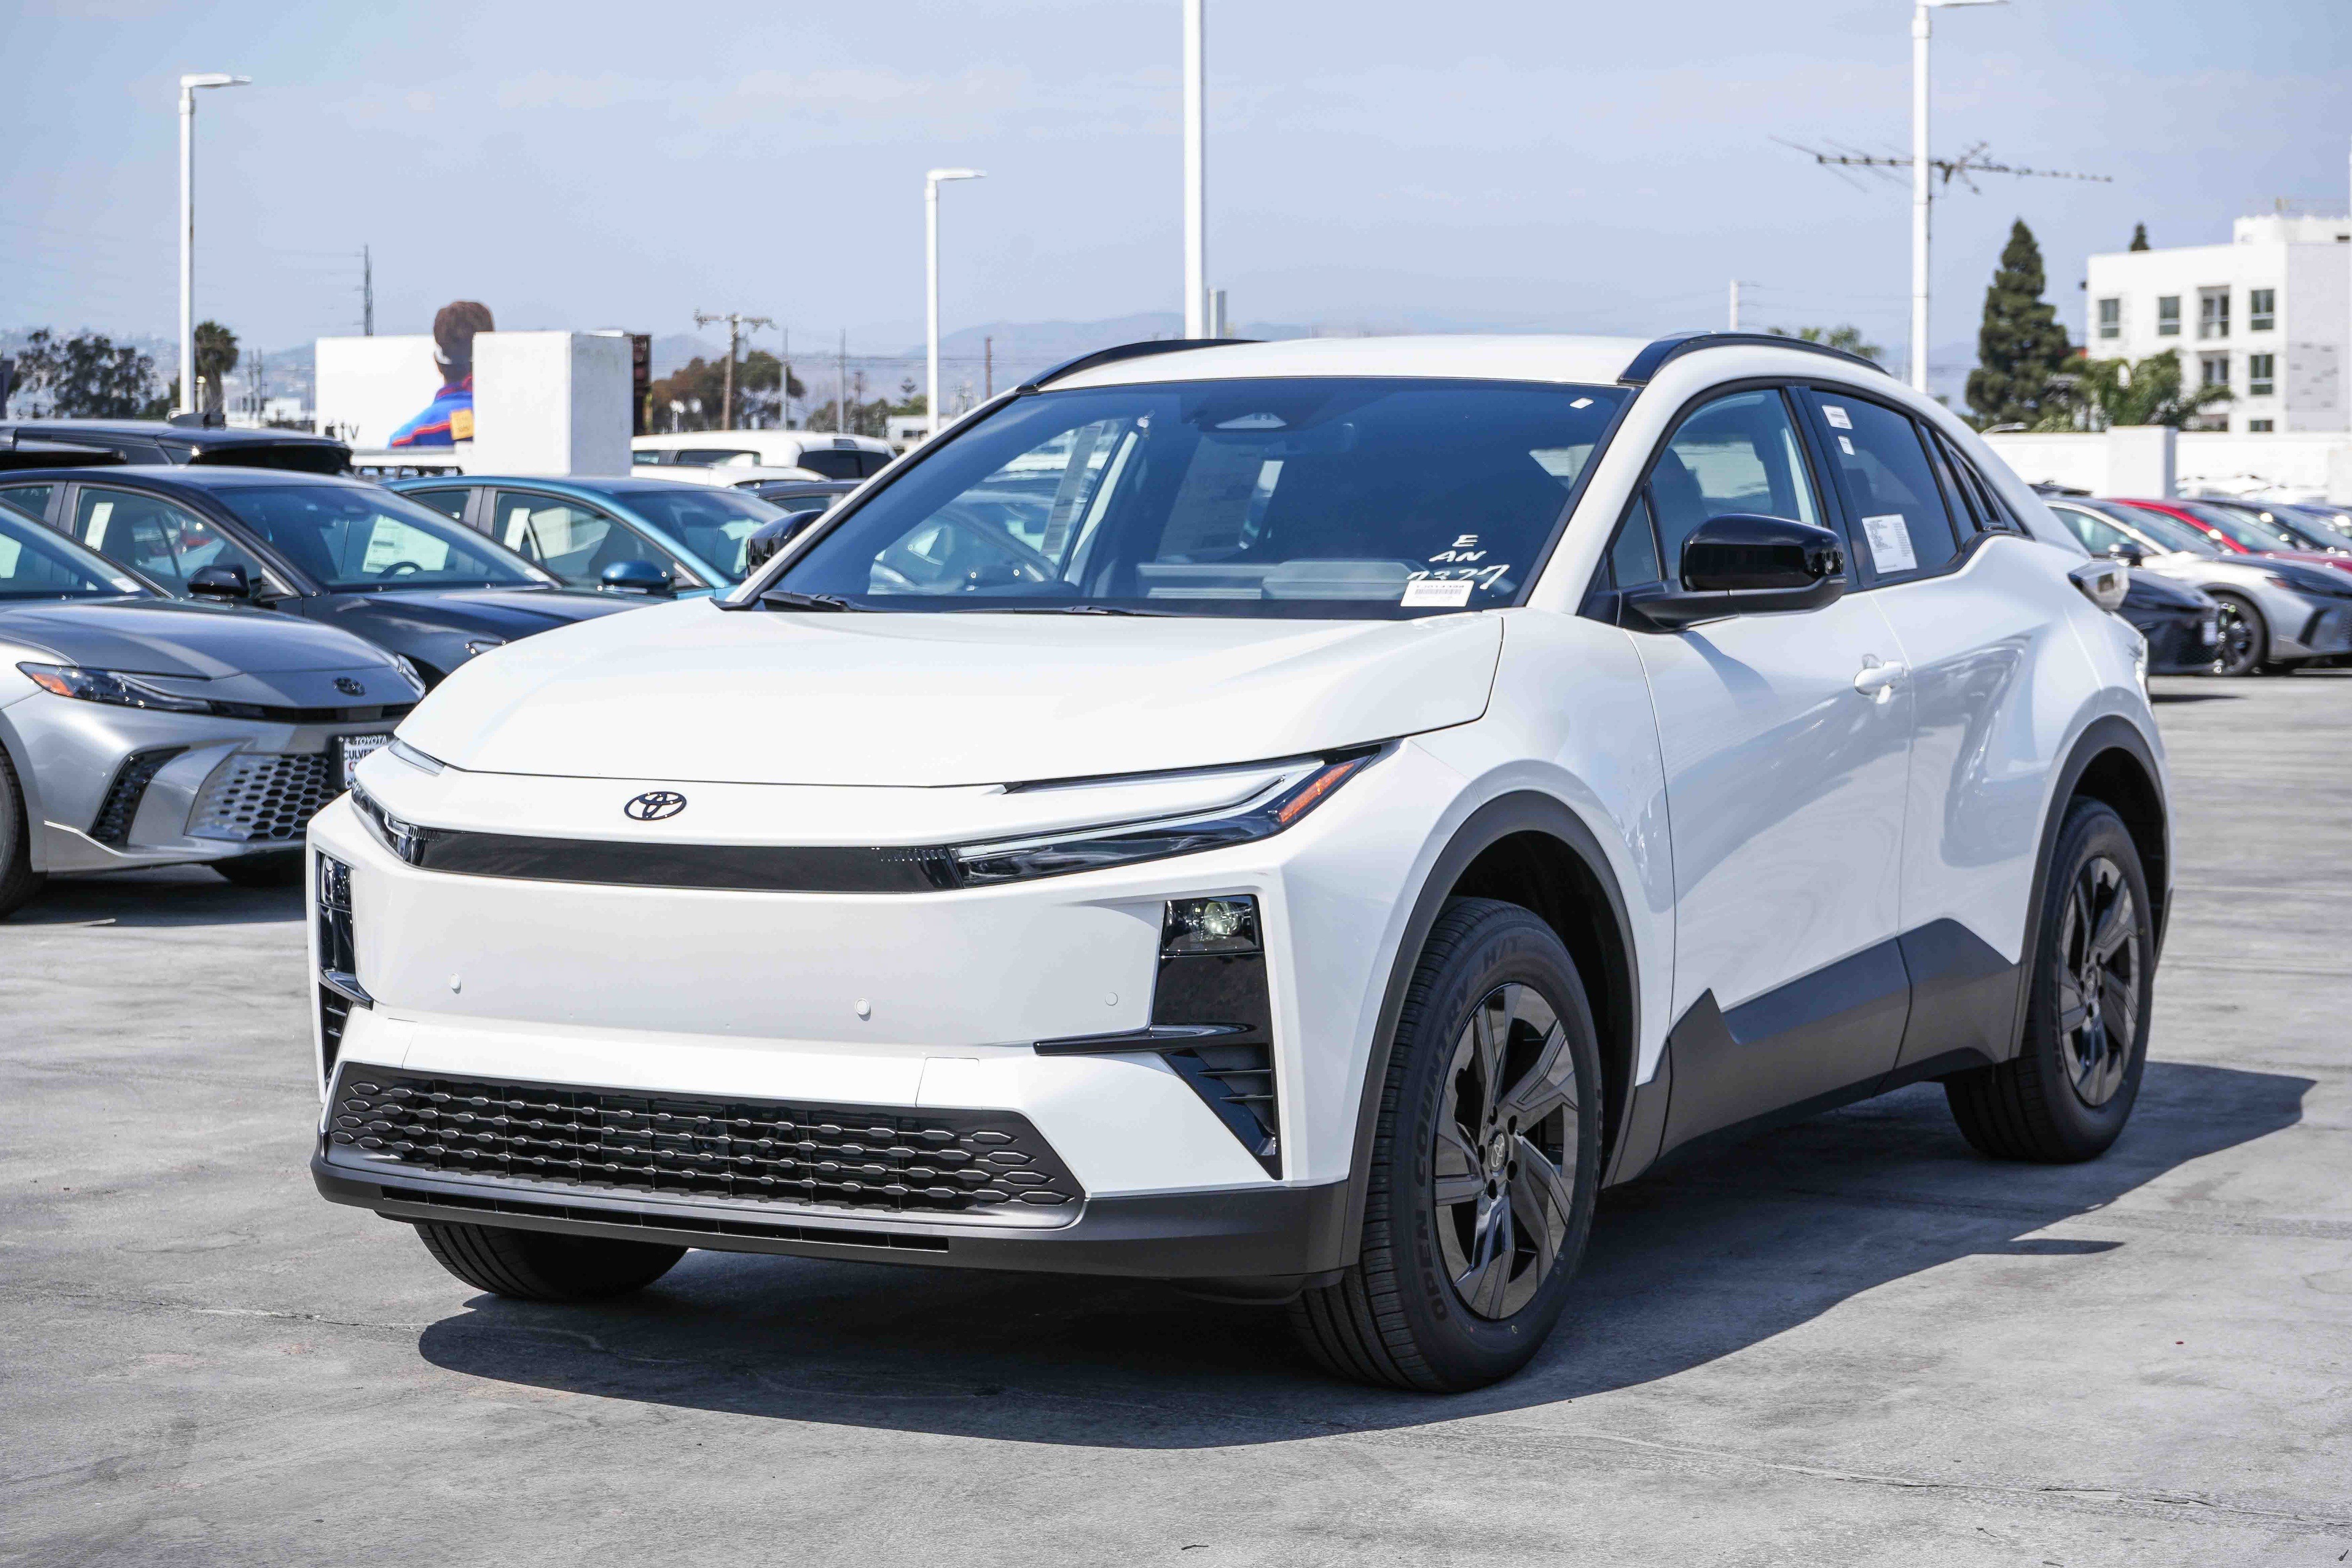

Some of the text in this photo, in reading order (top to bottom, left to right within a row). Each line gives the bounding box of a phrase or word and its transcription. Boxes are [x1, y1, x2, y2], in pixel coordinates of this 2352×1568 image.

[1452, 534, 1478, 547] E
[1428, 550, 1487, 562] AN
[355, 735, 387, 746] TOYOTA
[343, 748, 374, 760] CULVE
